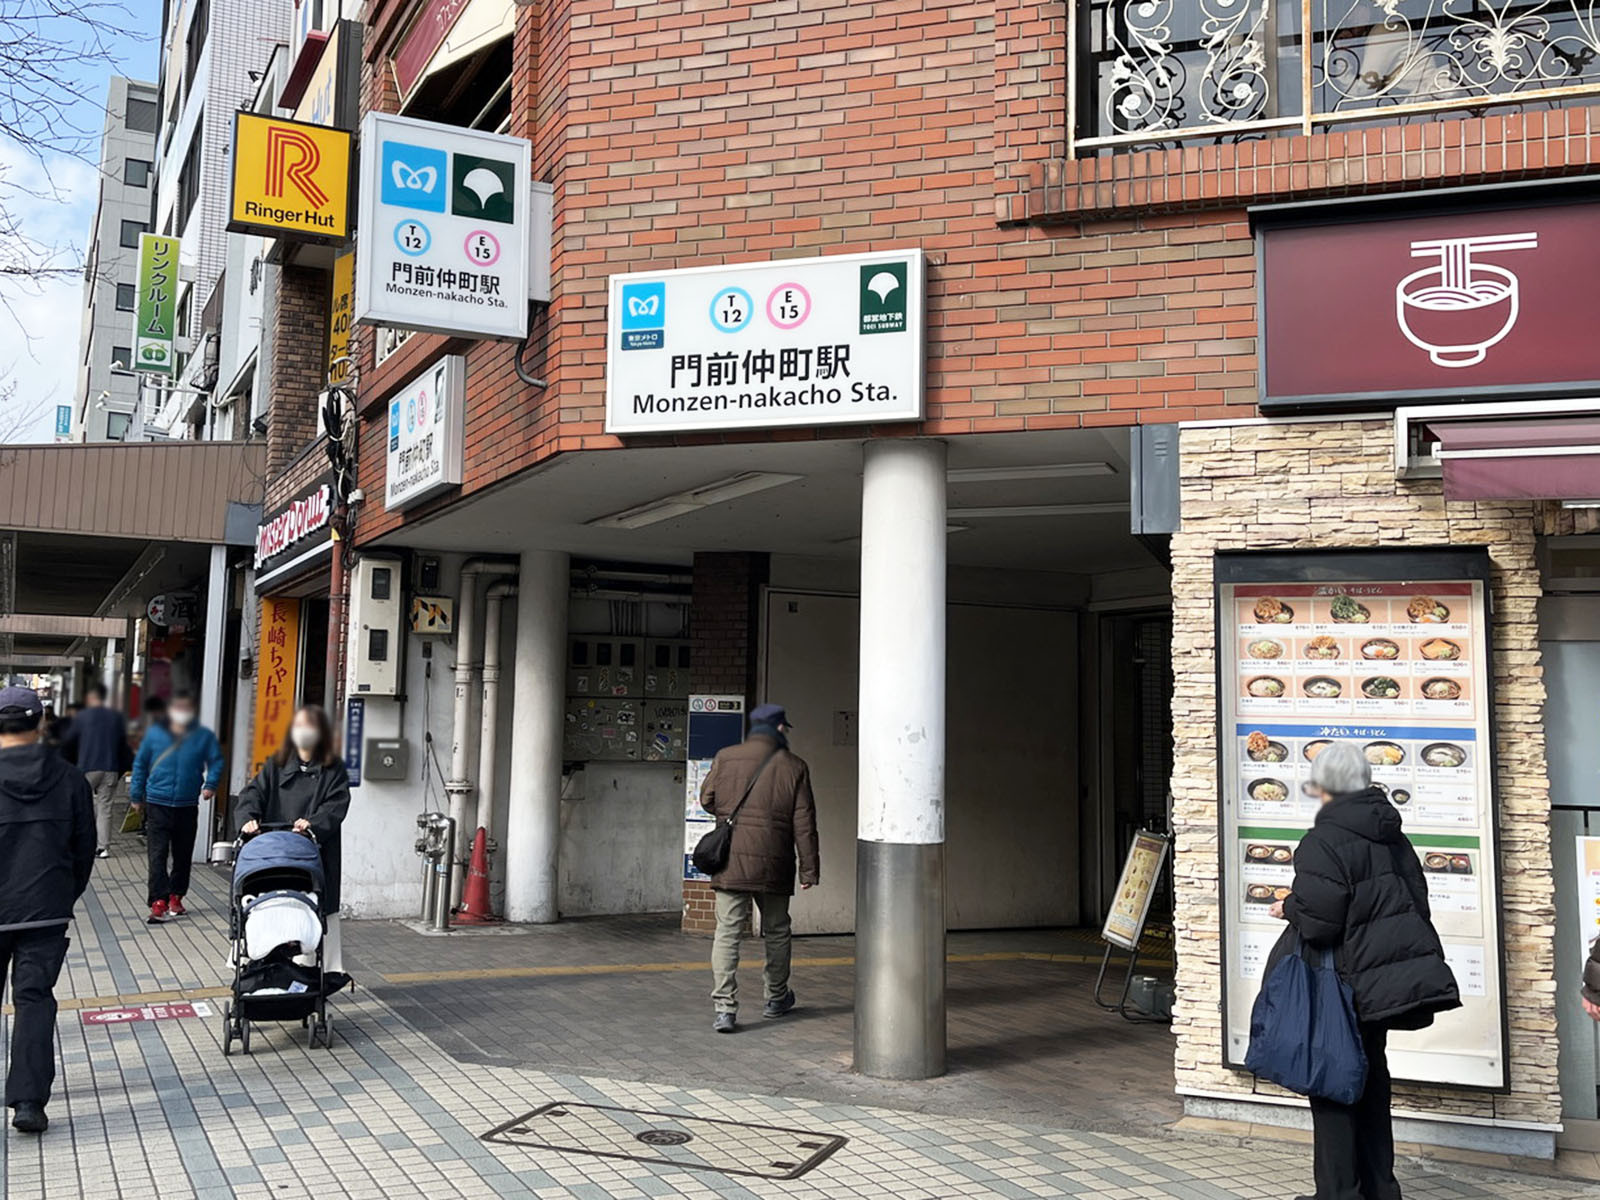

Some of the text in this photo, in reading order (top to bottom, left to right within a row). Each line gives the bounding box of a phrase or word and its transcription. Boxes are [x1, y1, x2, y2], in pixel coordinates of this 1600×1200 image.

[245, 201, 335, 228] Ringer Hut
[409, 225, 417, 236] T
[404, 236, 422, 249] 12
[479, 236, 486, 246] E
[474, 247, 491, 259] 15
[392, 262, 500, 295] 門前仲町駅
[146, 241, 169, 335] リンクルーム
[386, 283, 509, 308] Monzen-nakacho Sta.
[727, 295, 736, 307] T
[785, 291, 792, 303] E
[722, 310, 742, 323] 12
[779, 305, 799, 319] 15
[670, 343, 851, 388] 門前仲町駅
[633, 381, 897, 414] Monzen-nakacho Sta.
[261, 602, 288, 747] 長崎ちゃんぽん
[1319, 727, 1350, 737] 冷たい
